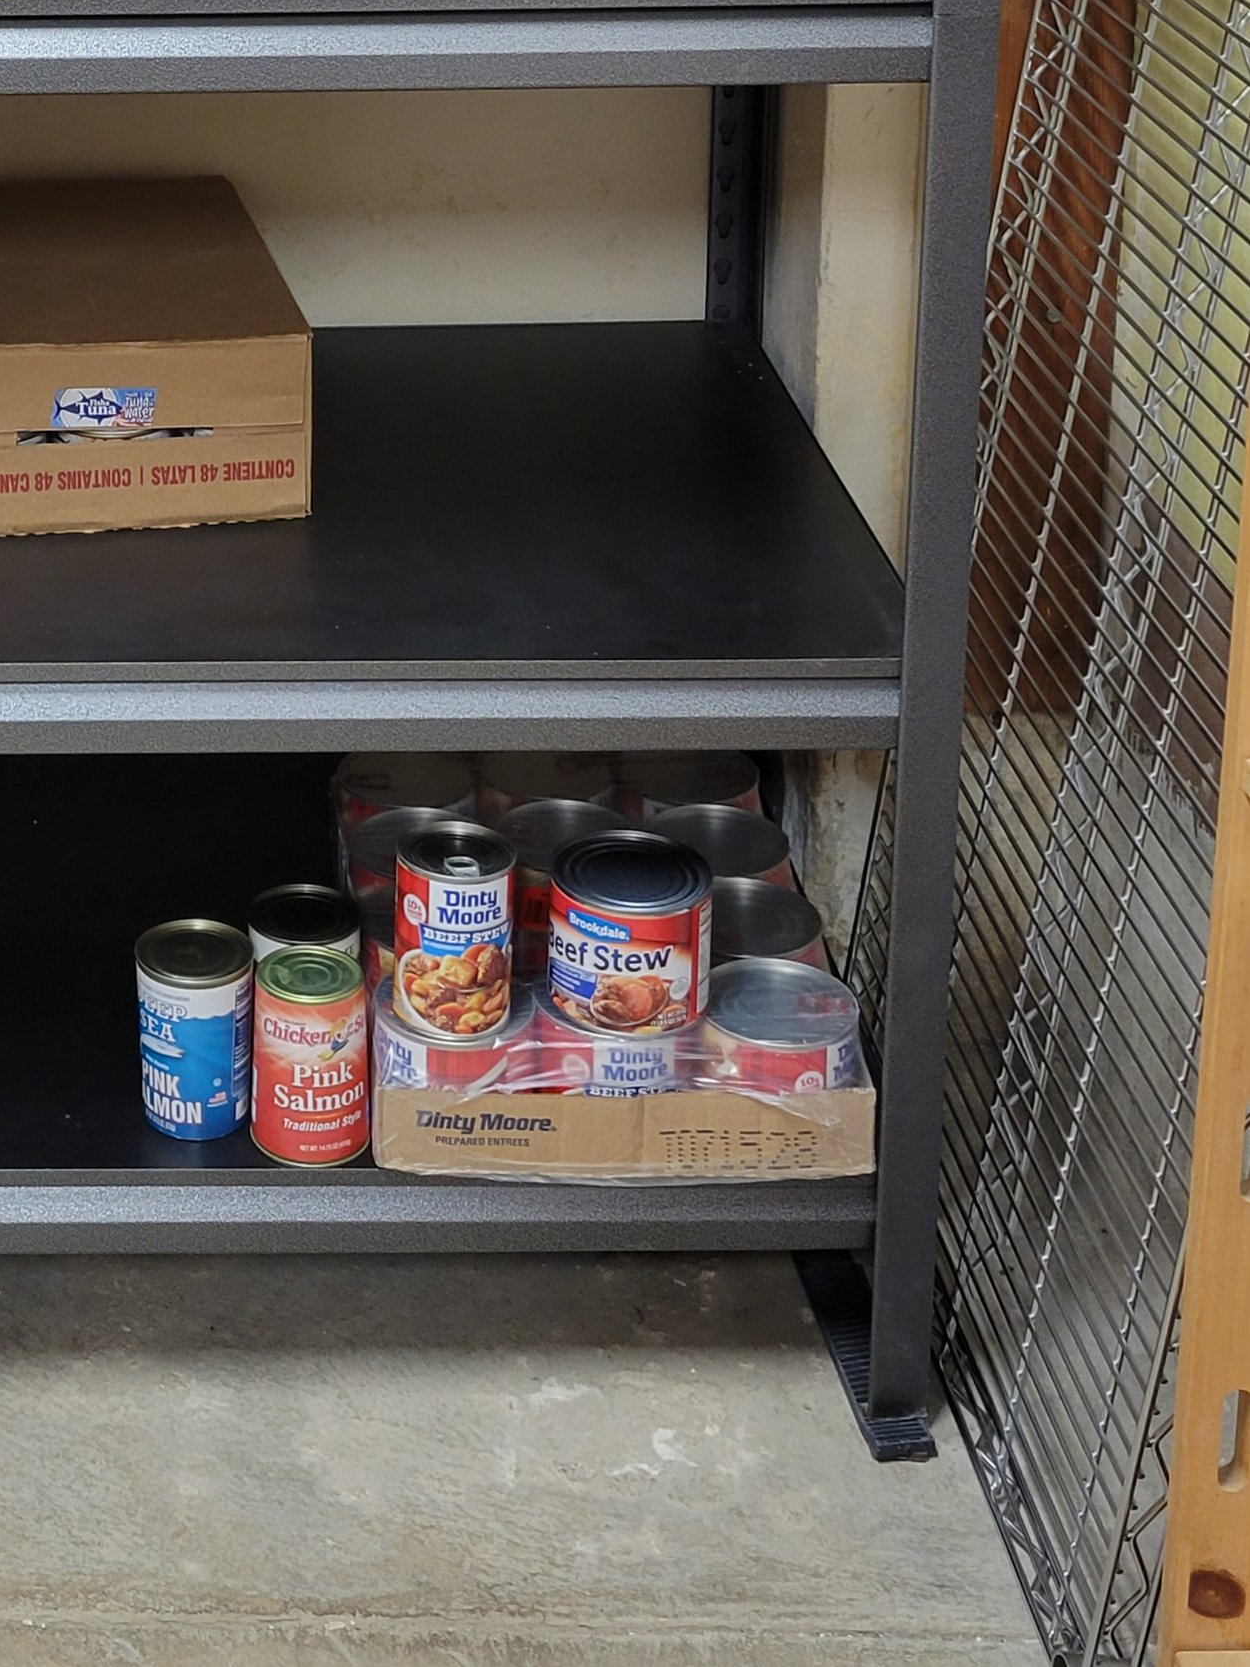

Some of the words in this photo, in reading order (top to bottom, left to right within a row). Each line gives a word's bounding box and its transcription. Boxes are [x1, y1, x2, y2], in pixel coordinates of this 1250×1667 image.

[75, 401, 118, 416] Tuna
[57, 468, 132, 490] CONTAINS
[151, 465, 196, 486] LATAS
[200, 464, 218, 483] 48
[223, 459, 295, 482] CONTIENE
[34, 472, 53, 492] 48
[442, 888, 499, 910] Dinty
[436, 905, 502, 925] Moore
[142, 1060, 181, 1098] PINK
[292, 1061, 353, 1088] Pink
[273, 1081, 364, 1112] Salmon
[416, 1109, 475, 1133] Dinty
[479, 1112, 553, 1132] Moore
[435, 1136, 486, 1147] PREPARED
[488, 1137, 530, 1148] ENTREES
